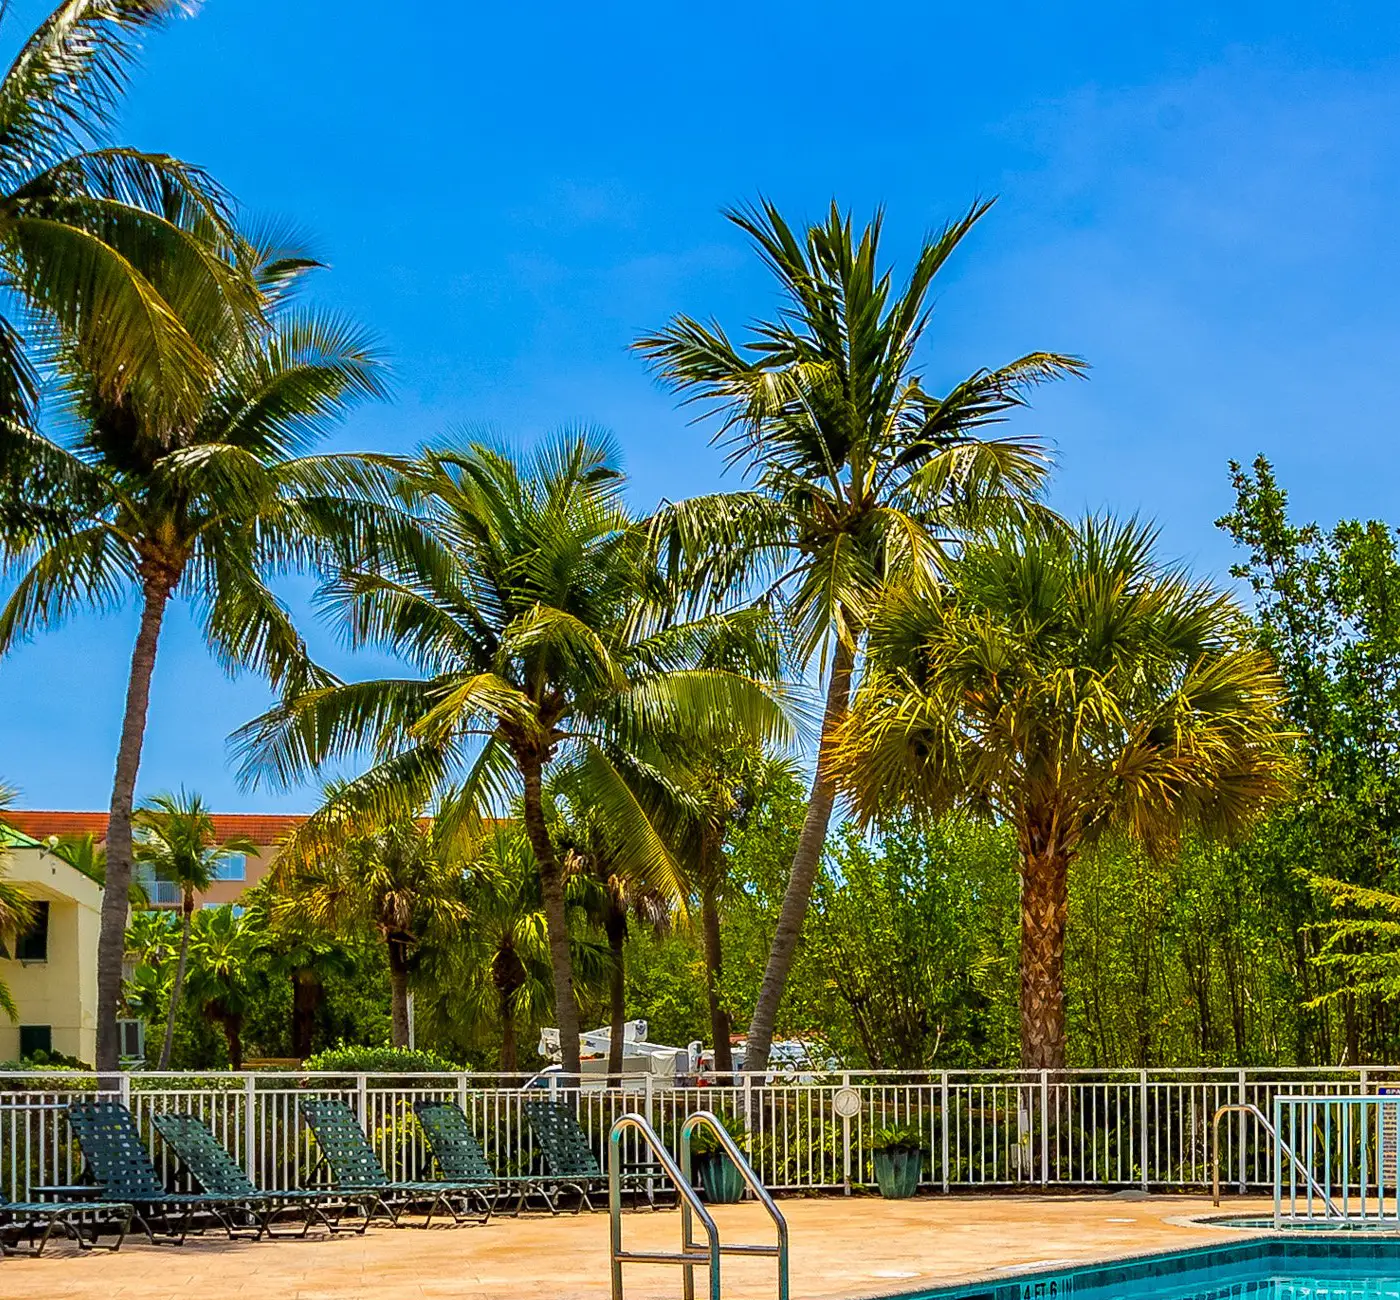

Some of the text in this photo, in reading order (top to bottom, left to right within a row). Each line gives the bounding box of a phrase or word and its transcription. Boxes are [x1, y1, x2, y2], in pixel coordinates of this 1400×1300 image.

[1024, 1278, 1072, 1300] 4 FT 6 IN
